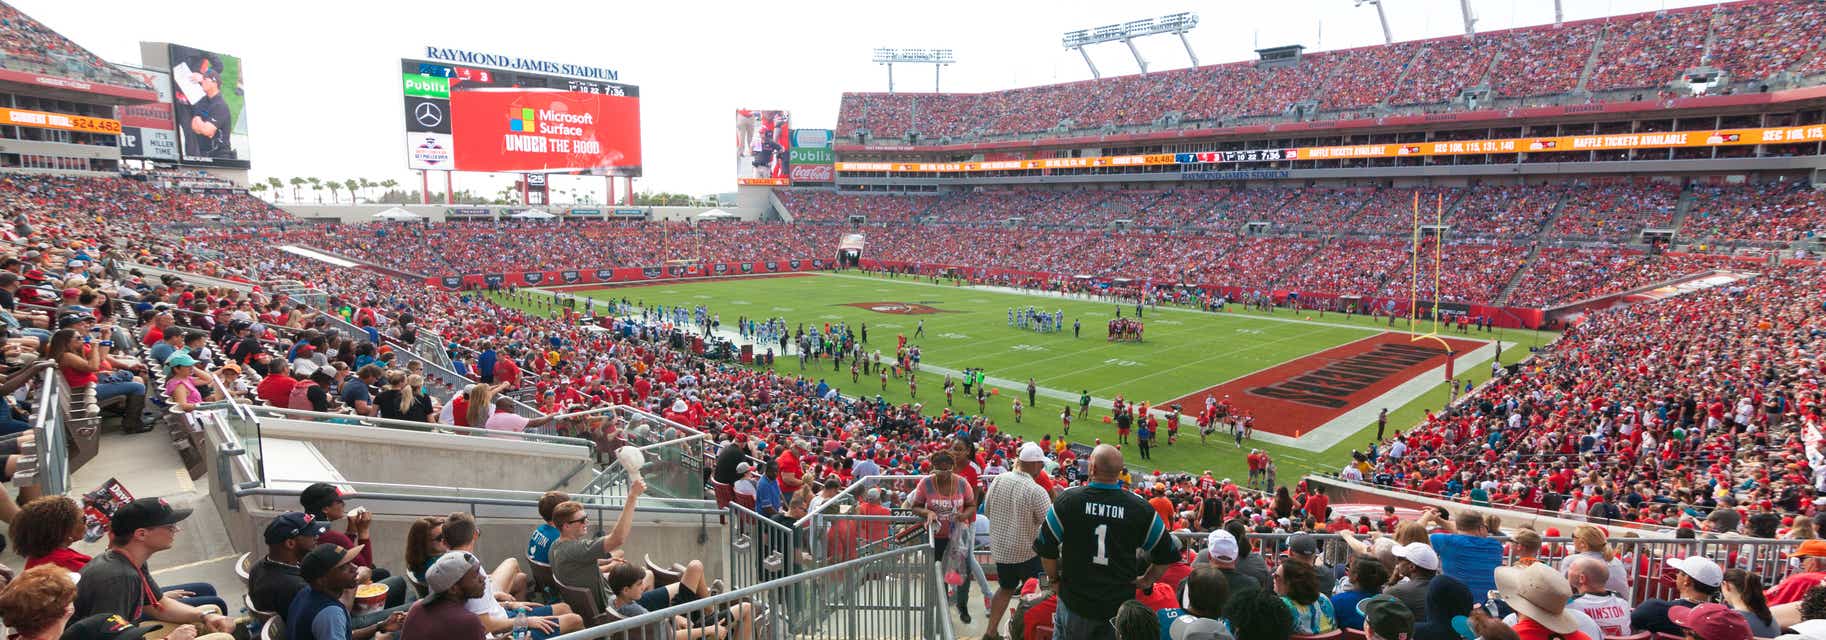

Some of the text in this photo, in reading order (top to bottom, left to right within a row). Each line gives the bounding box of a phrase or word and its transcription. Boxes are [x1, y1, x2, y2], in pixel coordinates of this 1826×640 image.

[427, 46, 618, 80] RAYMOND JAMES STADIUM
[444, 68, 451, 77] 7
[480, 72, 488, 81] 3
[405, 80, 445, 93] Publix
[540, 109, 592, 124] Microsoft
[73, 118, 120, 132] $24,482
[540, 122, 583, 136] Surface
[505, 134, 600, 154] UNDER THE HOOD
[790, 150, 832, 161] Publix
[1085, 501, 1125, 520] NEWTON
[1092, 523, 1109, 567] 1
[1583, 606, 1625, 620] WINSTON
